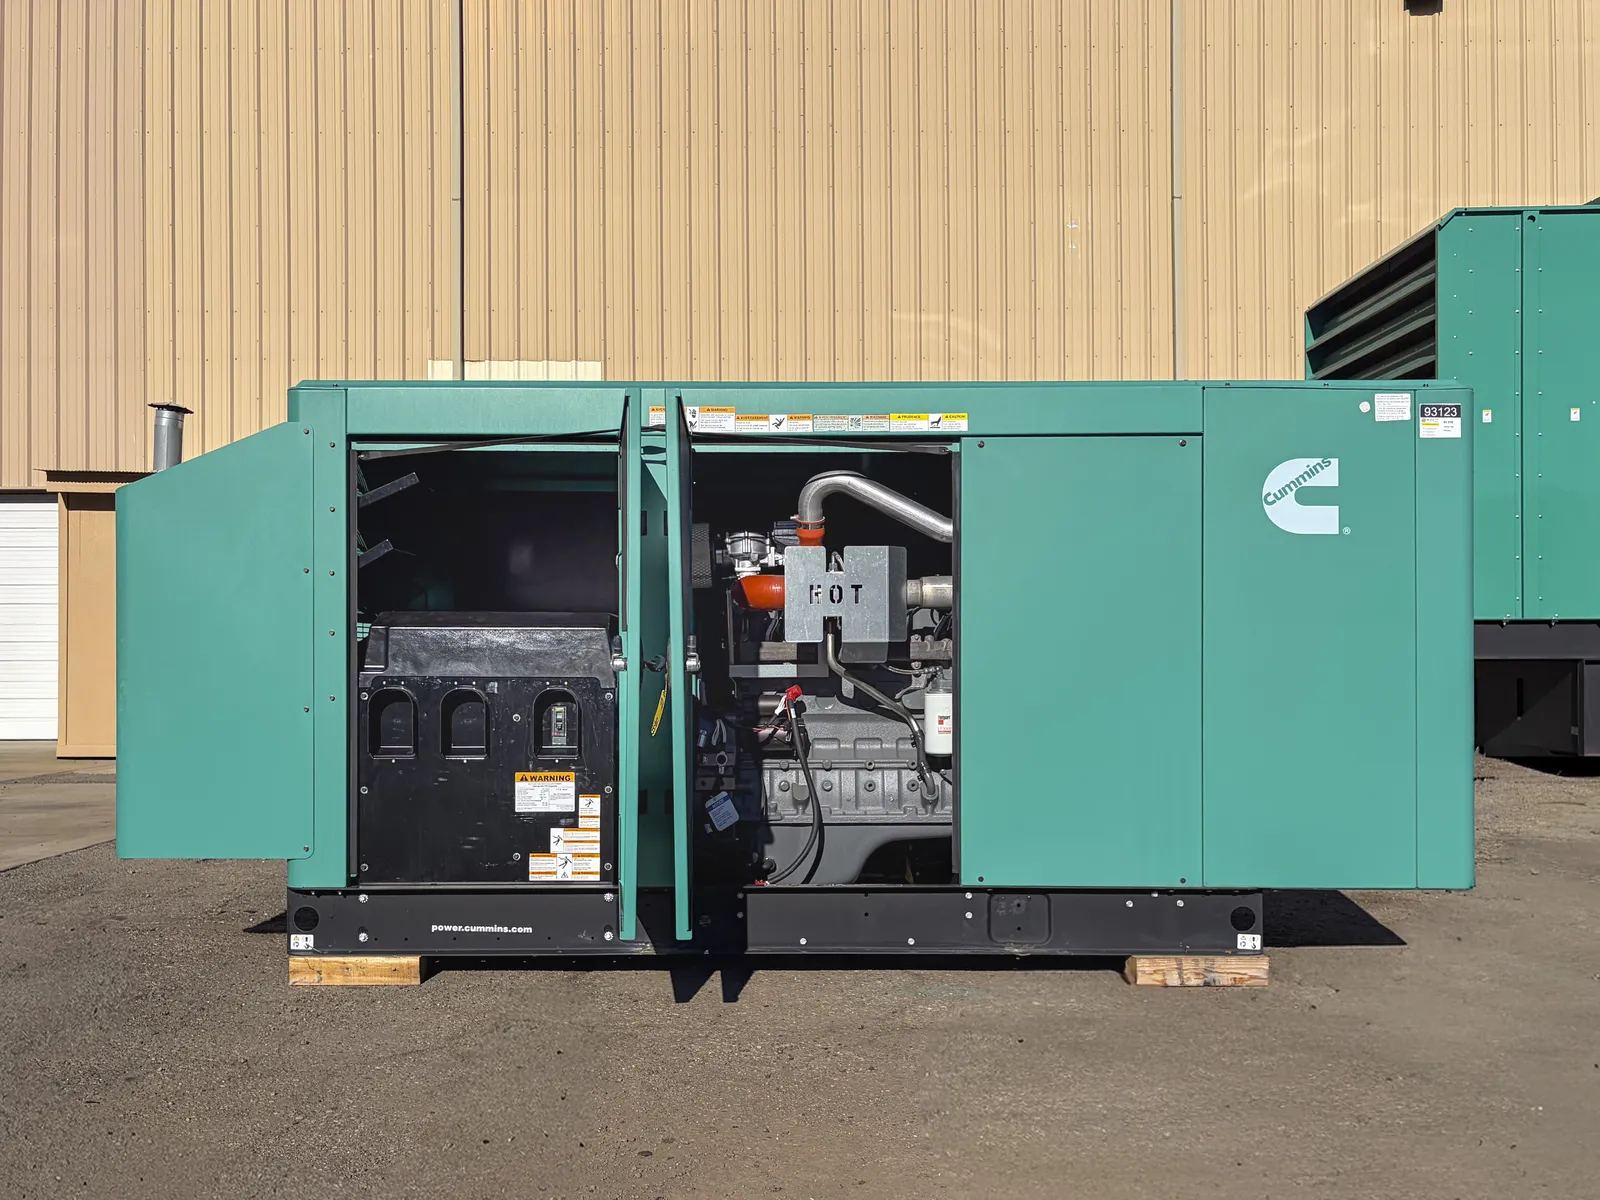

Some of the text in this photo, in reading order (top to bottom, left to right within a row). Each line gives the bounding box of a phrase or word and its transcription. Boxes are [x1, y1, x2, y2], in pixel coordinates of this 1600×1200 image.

[1424, 407, 1457, 417] 93123
[1263, 457, 1332, 506] Cummins
[809, 584, 863, 605] HOT
[431, 924, 533, 934] power.cummins.com
